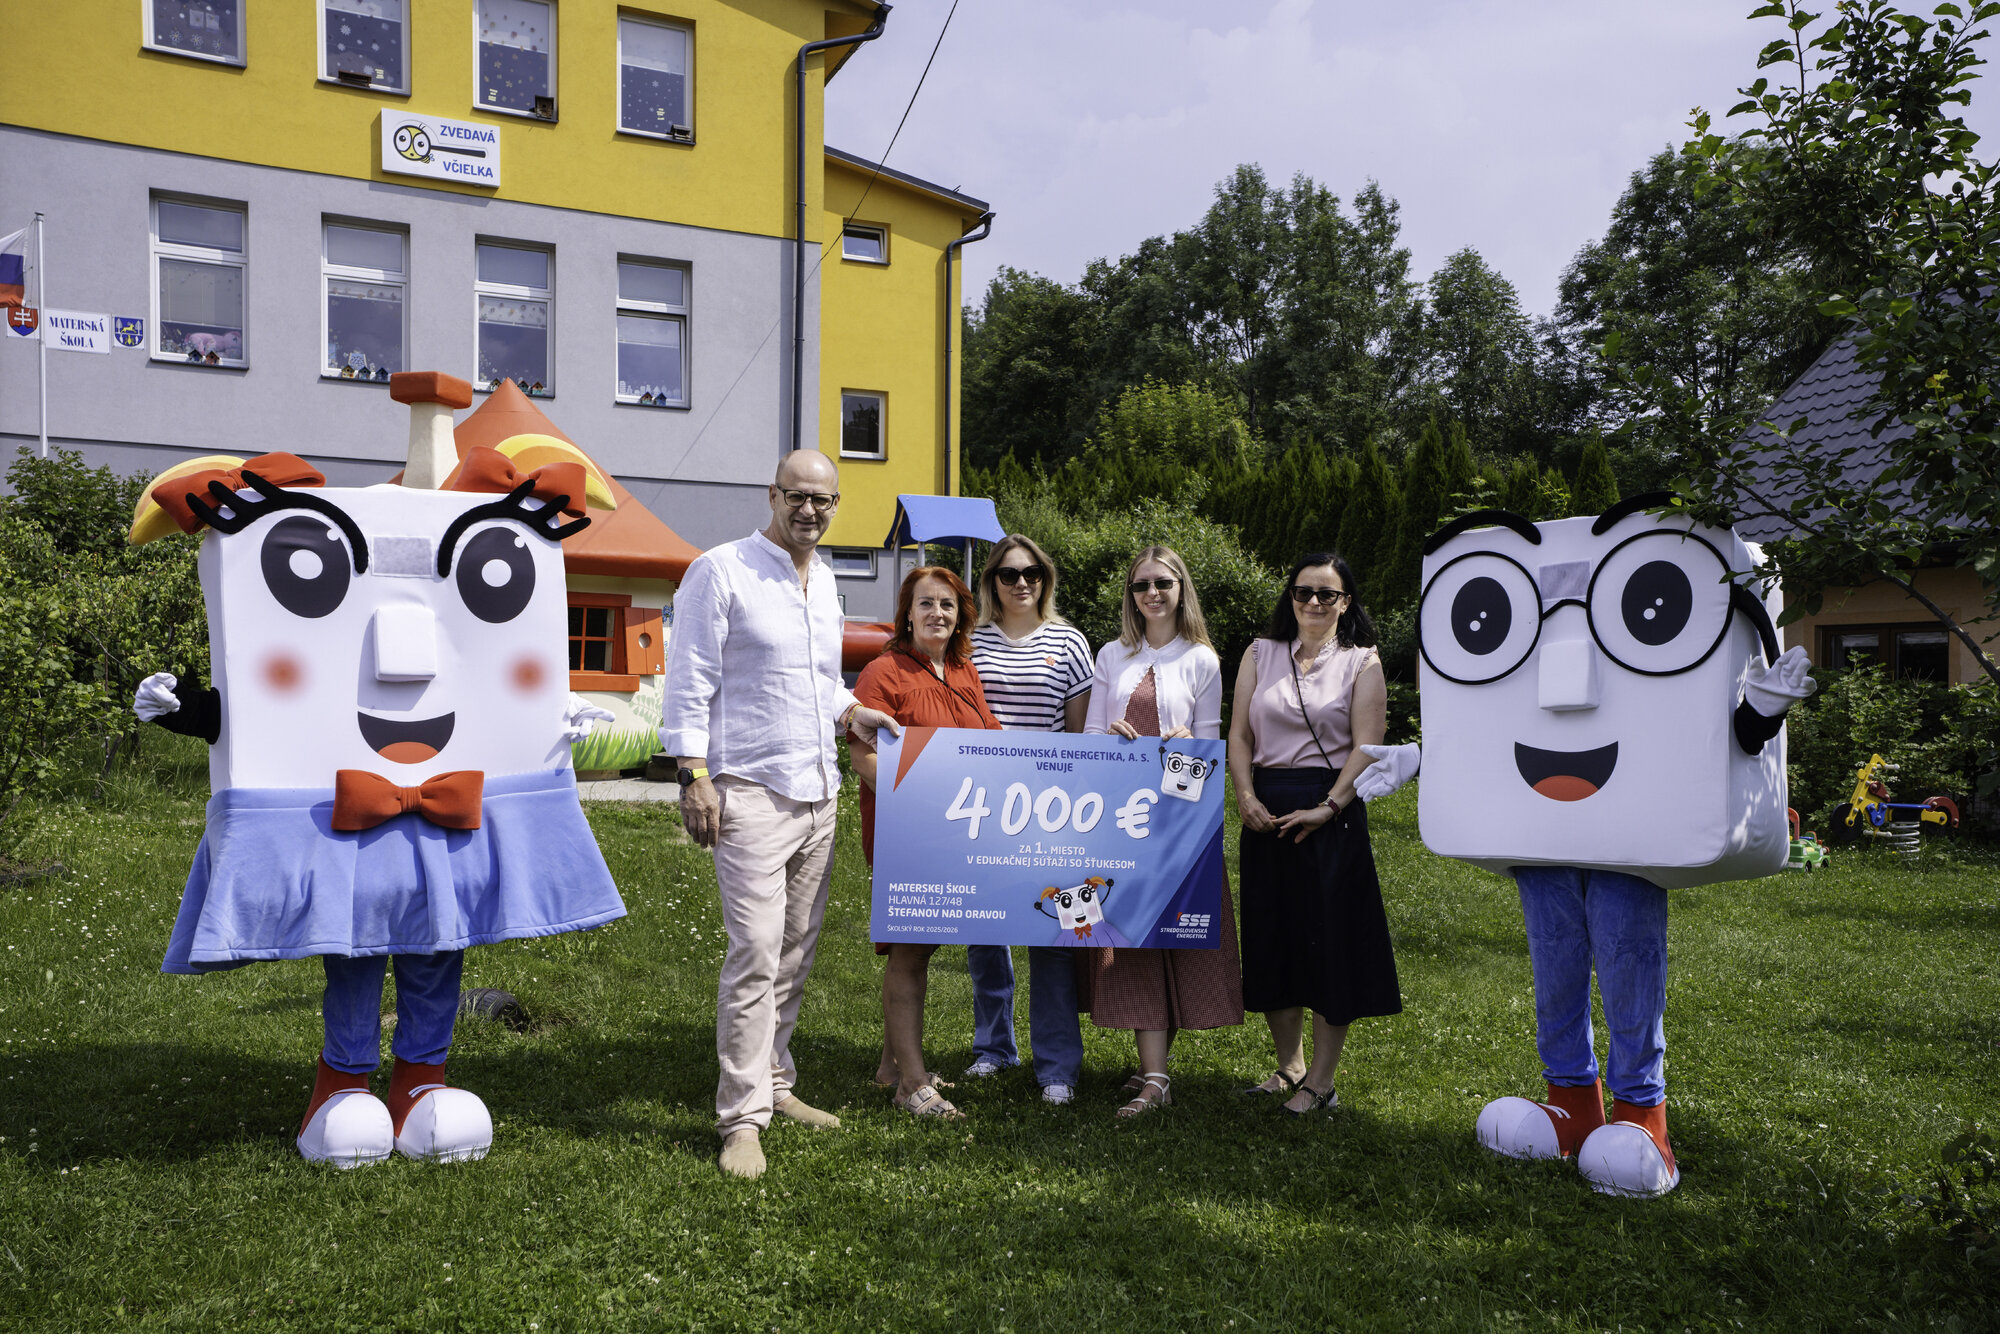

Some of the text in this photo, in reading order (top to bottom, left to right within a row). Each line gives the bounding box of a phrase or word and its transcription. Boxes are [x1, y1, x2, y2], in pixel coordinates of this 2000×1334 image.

[440, 125, 496, 143] ZVEDAVÁ
[442, 160, 494, 178] VČIELKA
[49, 316, 104, 332] MATERSKÁ
[60, 331, 94, 348] ŠKOLA
[958, 745, 1150, 763] STREDOSLOVENSKÁ ENERGETIKA, A. S.
[1036, 761, 1073, 773] VENUJE
[1115, 788, 1159, 839] €
[1019, 841, 1086, 855] ZA 1. MIESTO
[967, 855, 1136, 869] V EDUKAČNEJ SÚŤAŽI SO ŠŤUKESOM
[889, 883, 977, 895] MATERSKEJ ŠKOLE
[888, 894, 963, 906] HLAVNÁ 127/48
[888, 906, 1006, 919] ŠTEFANOV NAD ORAVOU
[1179, 914, 1210, 927] SSE
[887, 924, 912, 932] ŠKOLSKÝ
